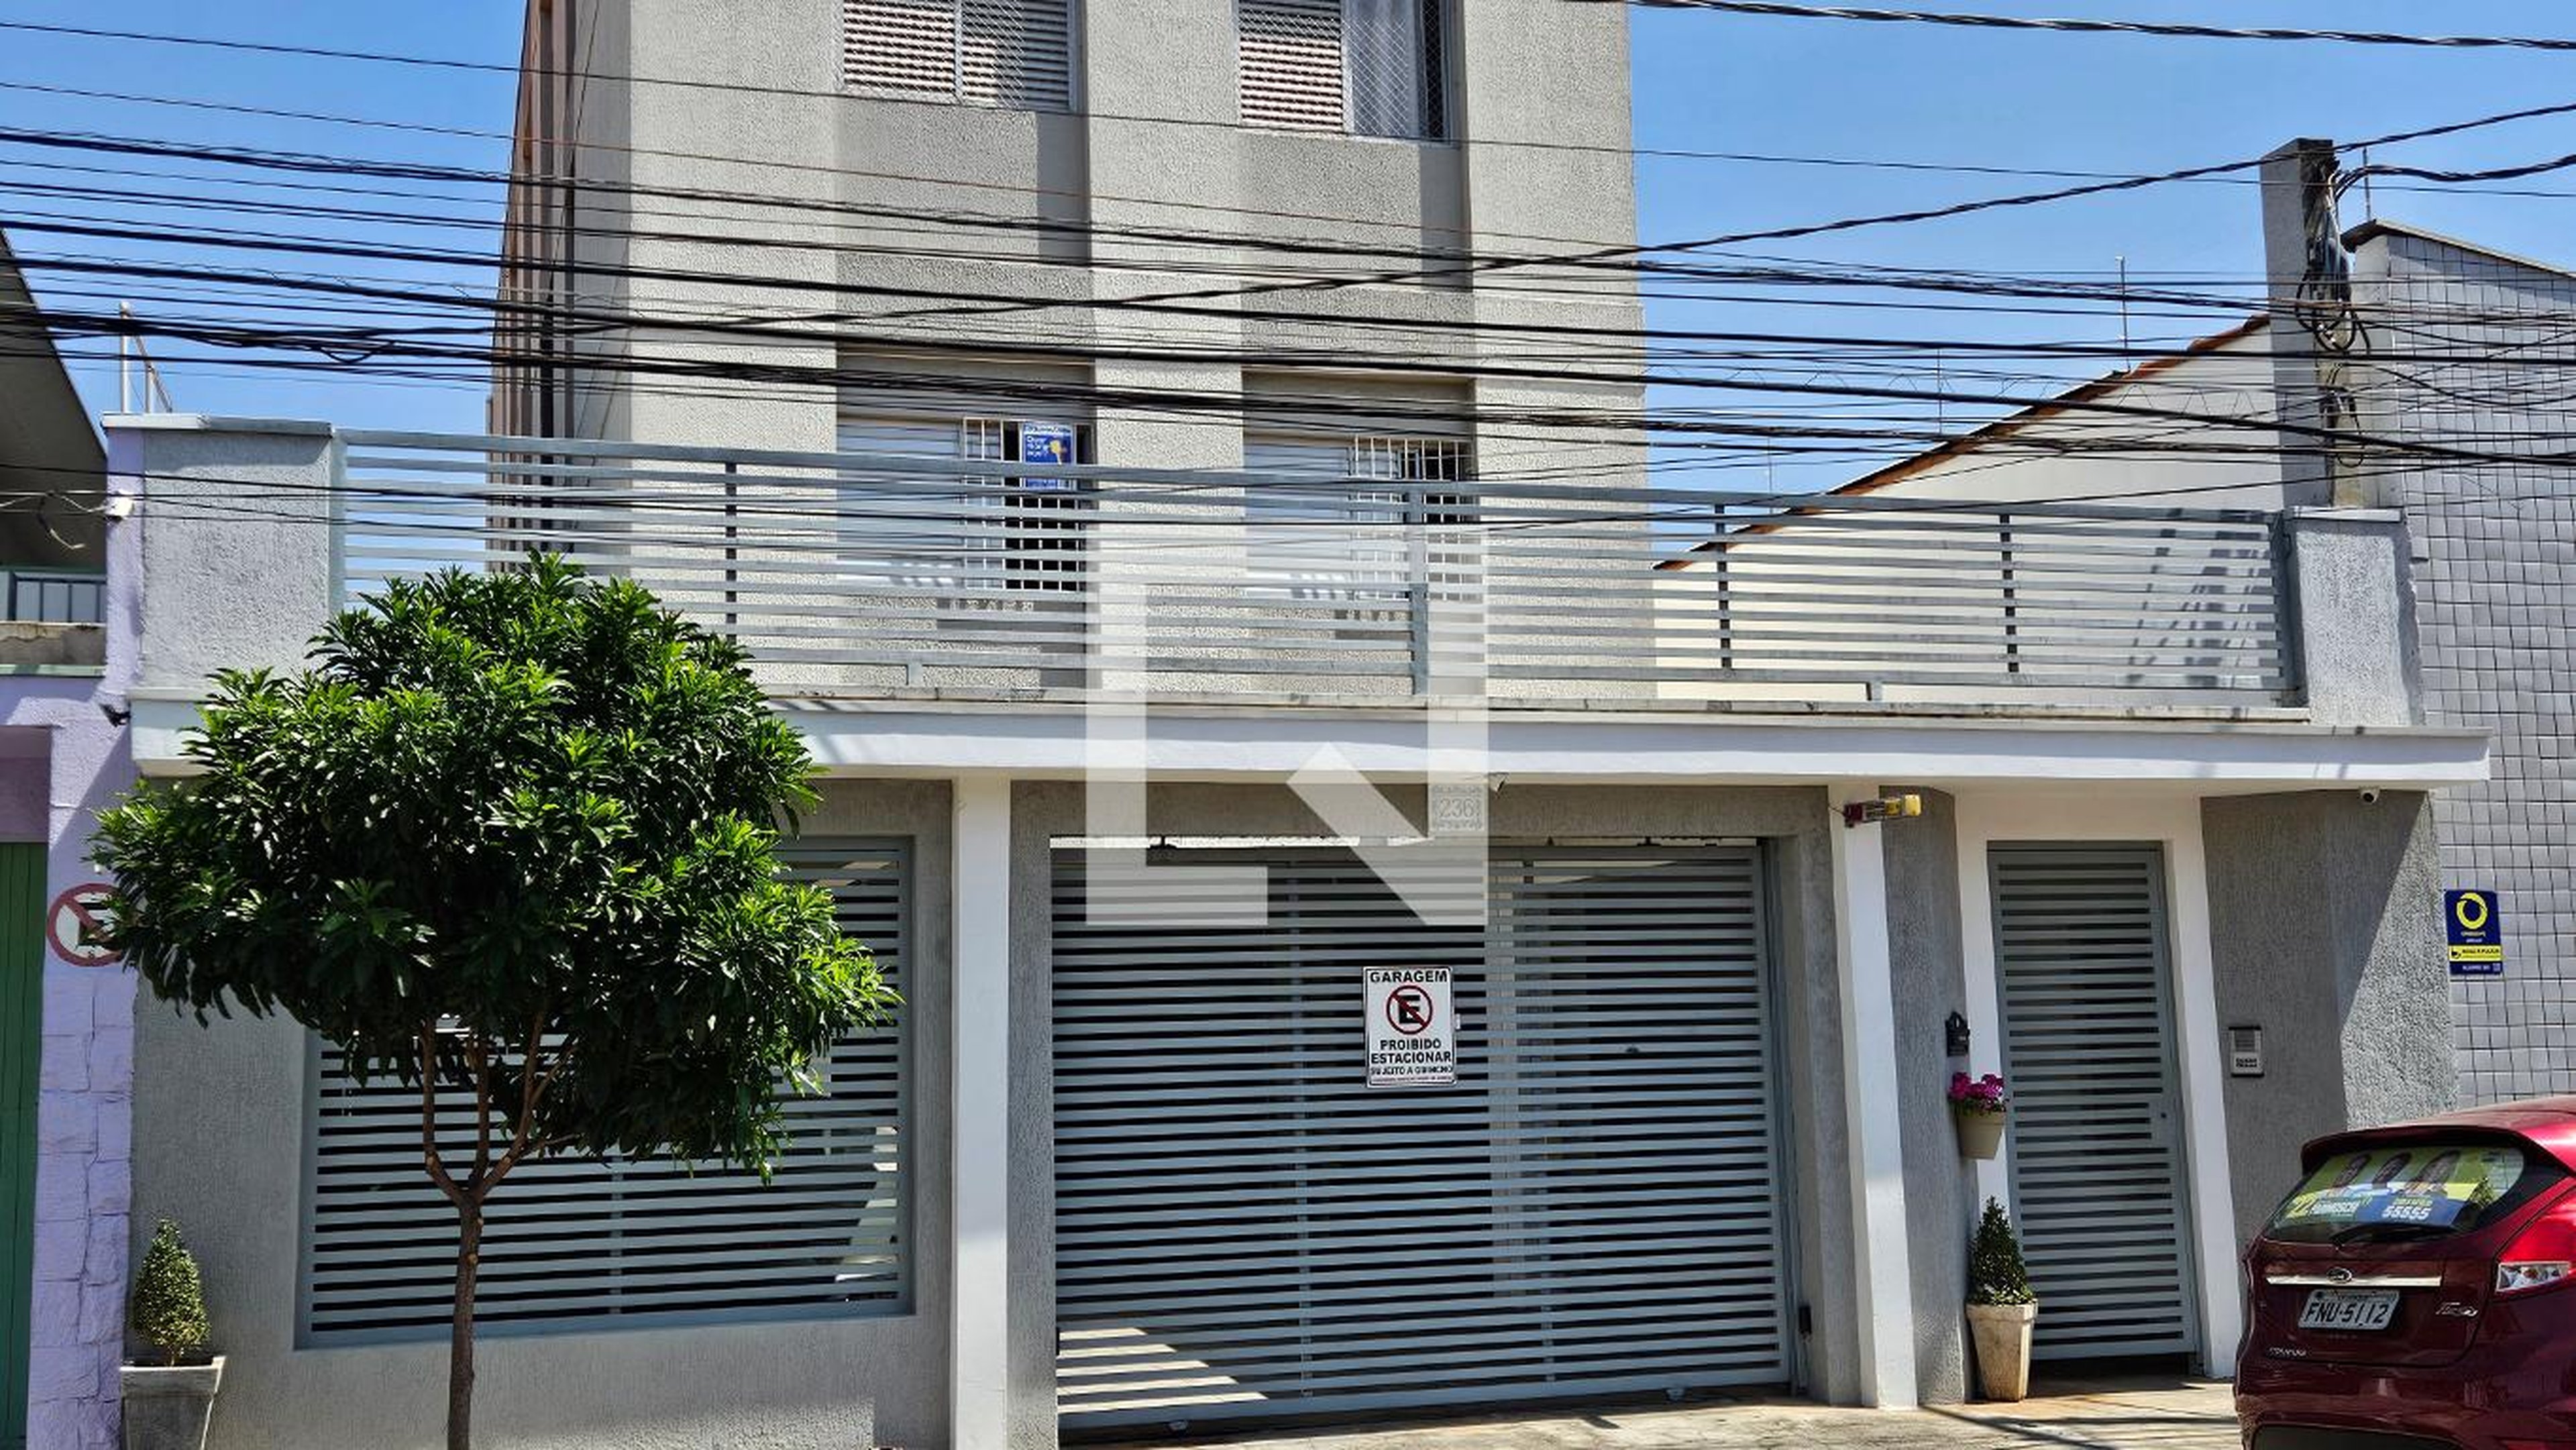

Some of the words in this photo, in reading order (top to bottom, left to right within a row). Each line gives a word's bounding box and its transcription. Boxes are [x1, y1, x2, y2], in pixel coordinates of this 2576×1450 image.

[1439, 797, 1474, 818] 236
[1370, 970, 1448, 983] GARAGEM
[1380, 1038, 1442, 1050] PROIBIDO
[1371, 1051, 1451, 1064] ESTACIONAR
